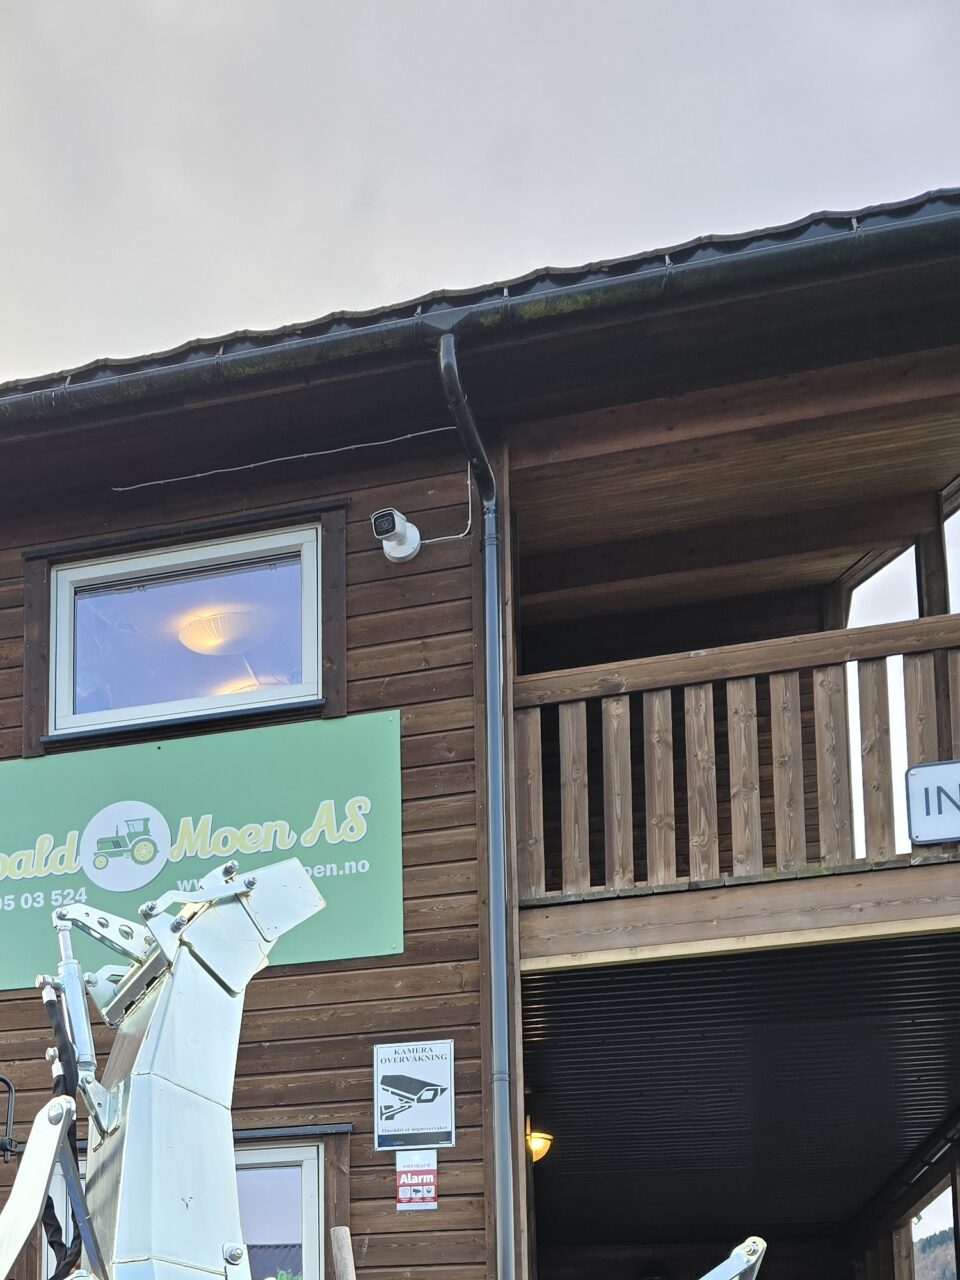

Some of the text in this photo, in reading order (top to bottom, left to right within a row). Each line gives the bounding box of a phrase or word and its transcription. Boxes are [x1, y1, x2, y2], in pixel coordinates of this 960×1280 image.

[168, 814, 297, 862] Moen
[300, 796, 371, 847] AS
[20, 891, 45, 909] 03
[50, 886, 88, 906] 524
[394, 1046, 434, 1056] KAMERA
[400, 1172, 434, 1184] Alarm
